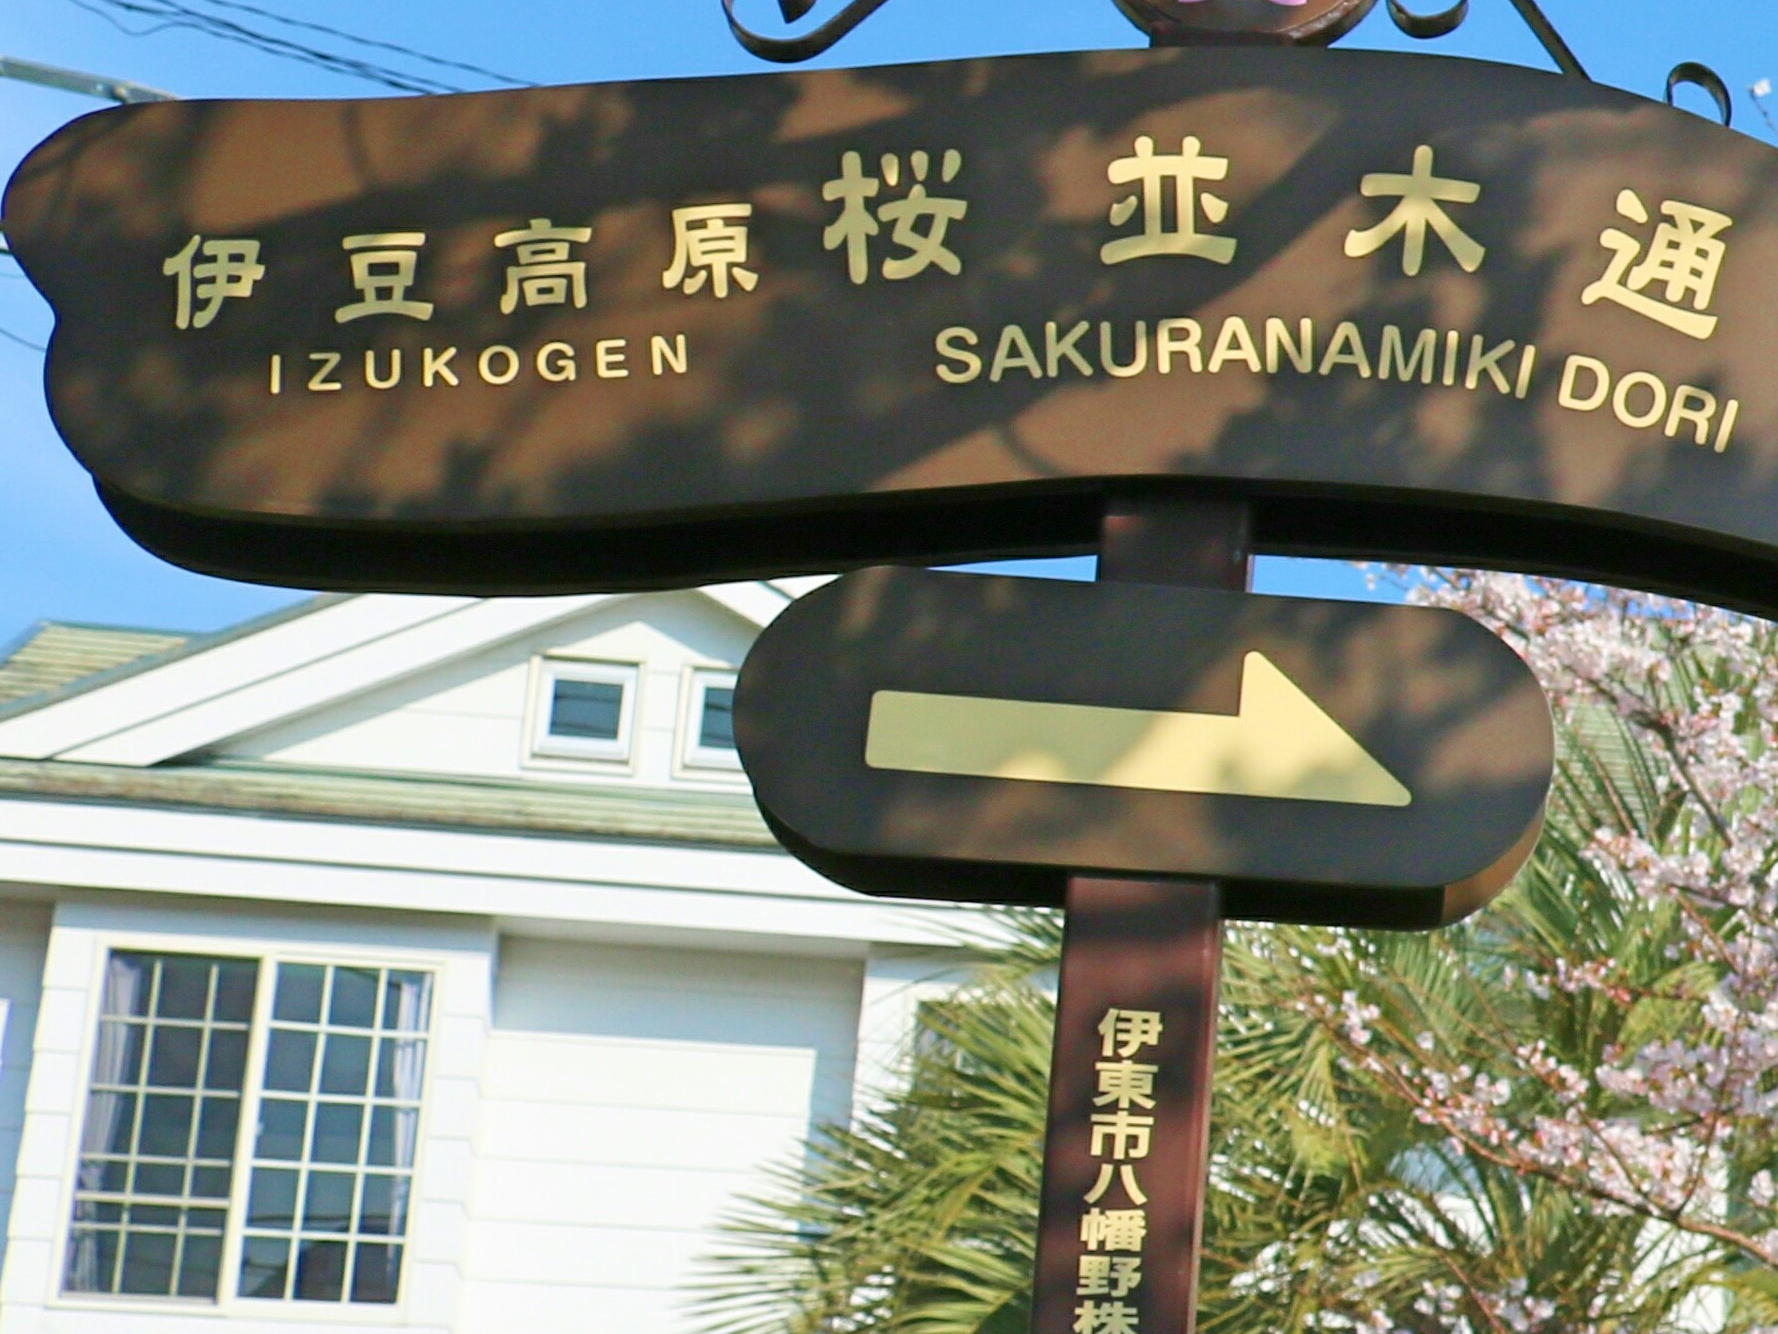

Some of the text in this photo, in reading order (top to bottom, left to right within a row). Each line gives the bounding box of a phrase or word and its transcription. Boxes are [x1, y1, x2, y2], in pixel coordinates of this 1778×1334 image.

[163, 202, 760, 330] 伊豆高原
[269, 317, 1740, 454] IZUKOGEN SAKURANAMIKI DORI
